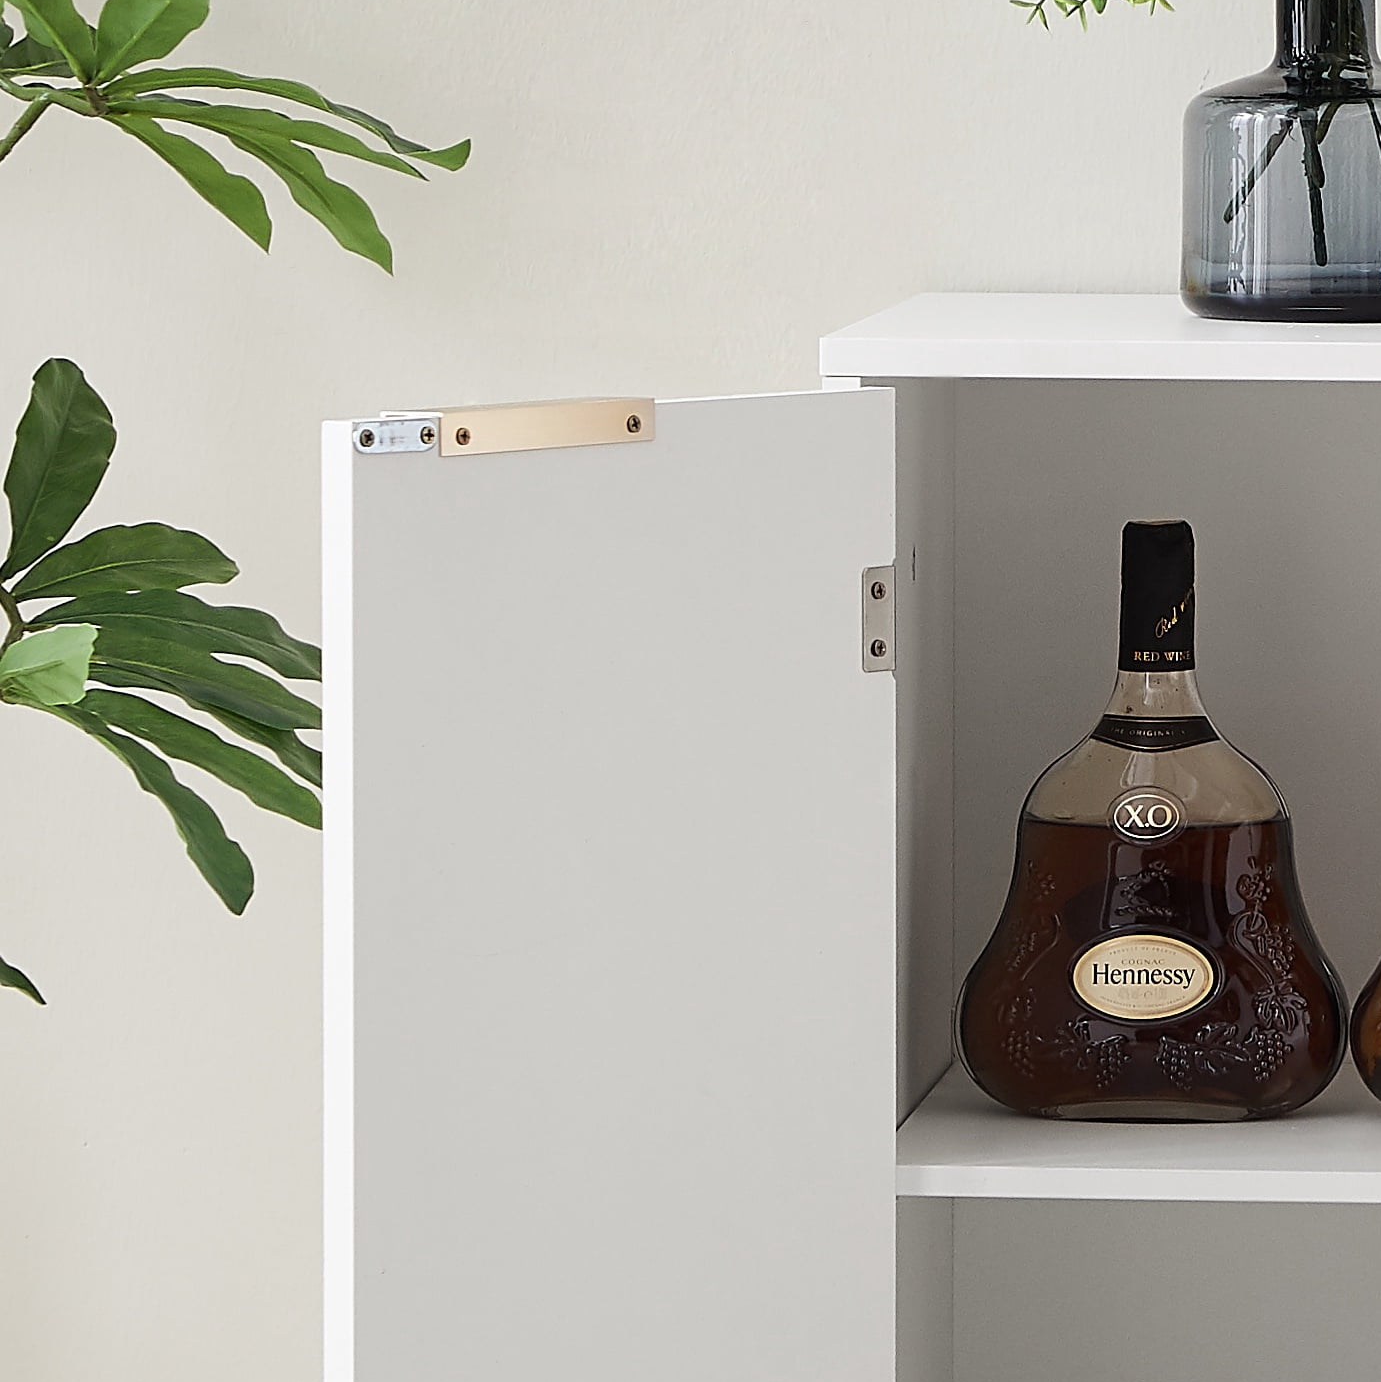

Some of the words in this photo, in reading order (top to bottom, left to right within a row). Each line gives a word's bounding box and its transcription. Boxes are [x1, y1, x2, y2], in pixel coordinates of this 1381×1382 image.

[1134, 651, 1160, 661] RED
[1164, 651, 1191, 661] WINE
[1123, 804, 1172, 828] X.O
[1121, 958, 1166, 966] COGNAC
[1092, 963, 1196, 990] Hennessy
